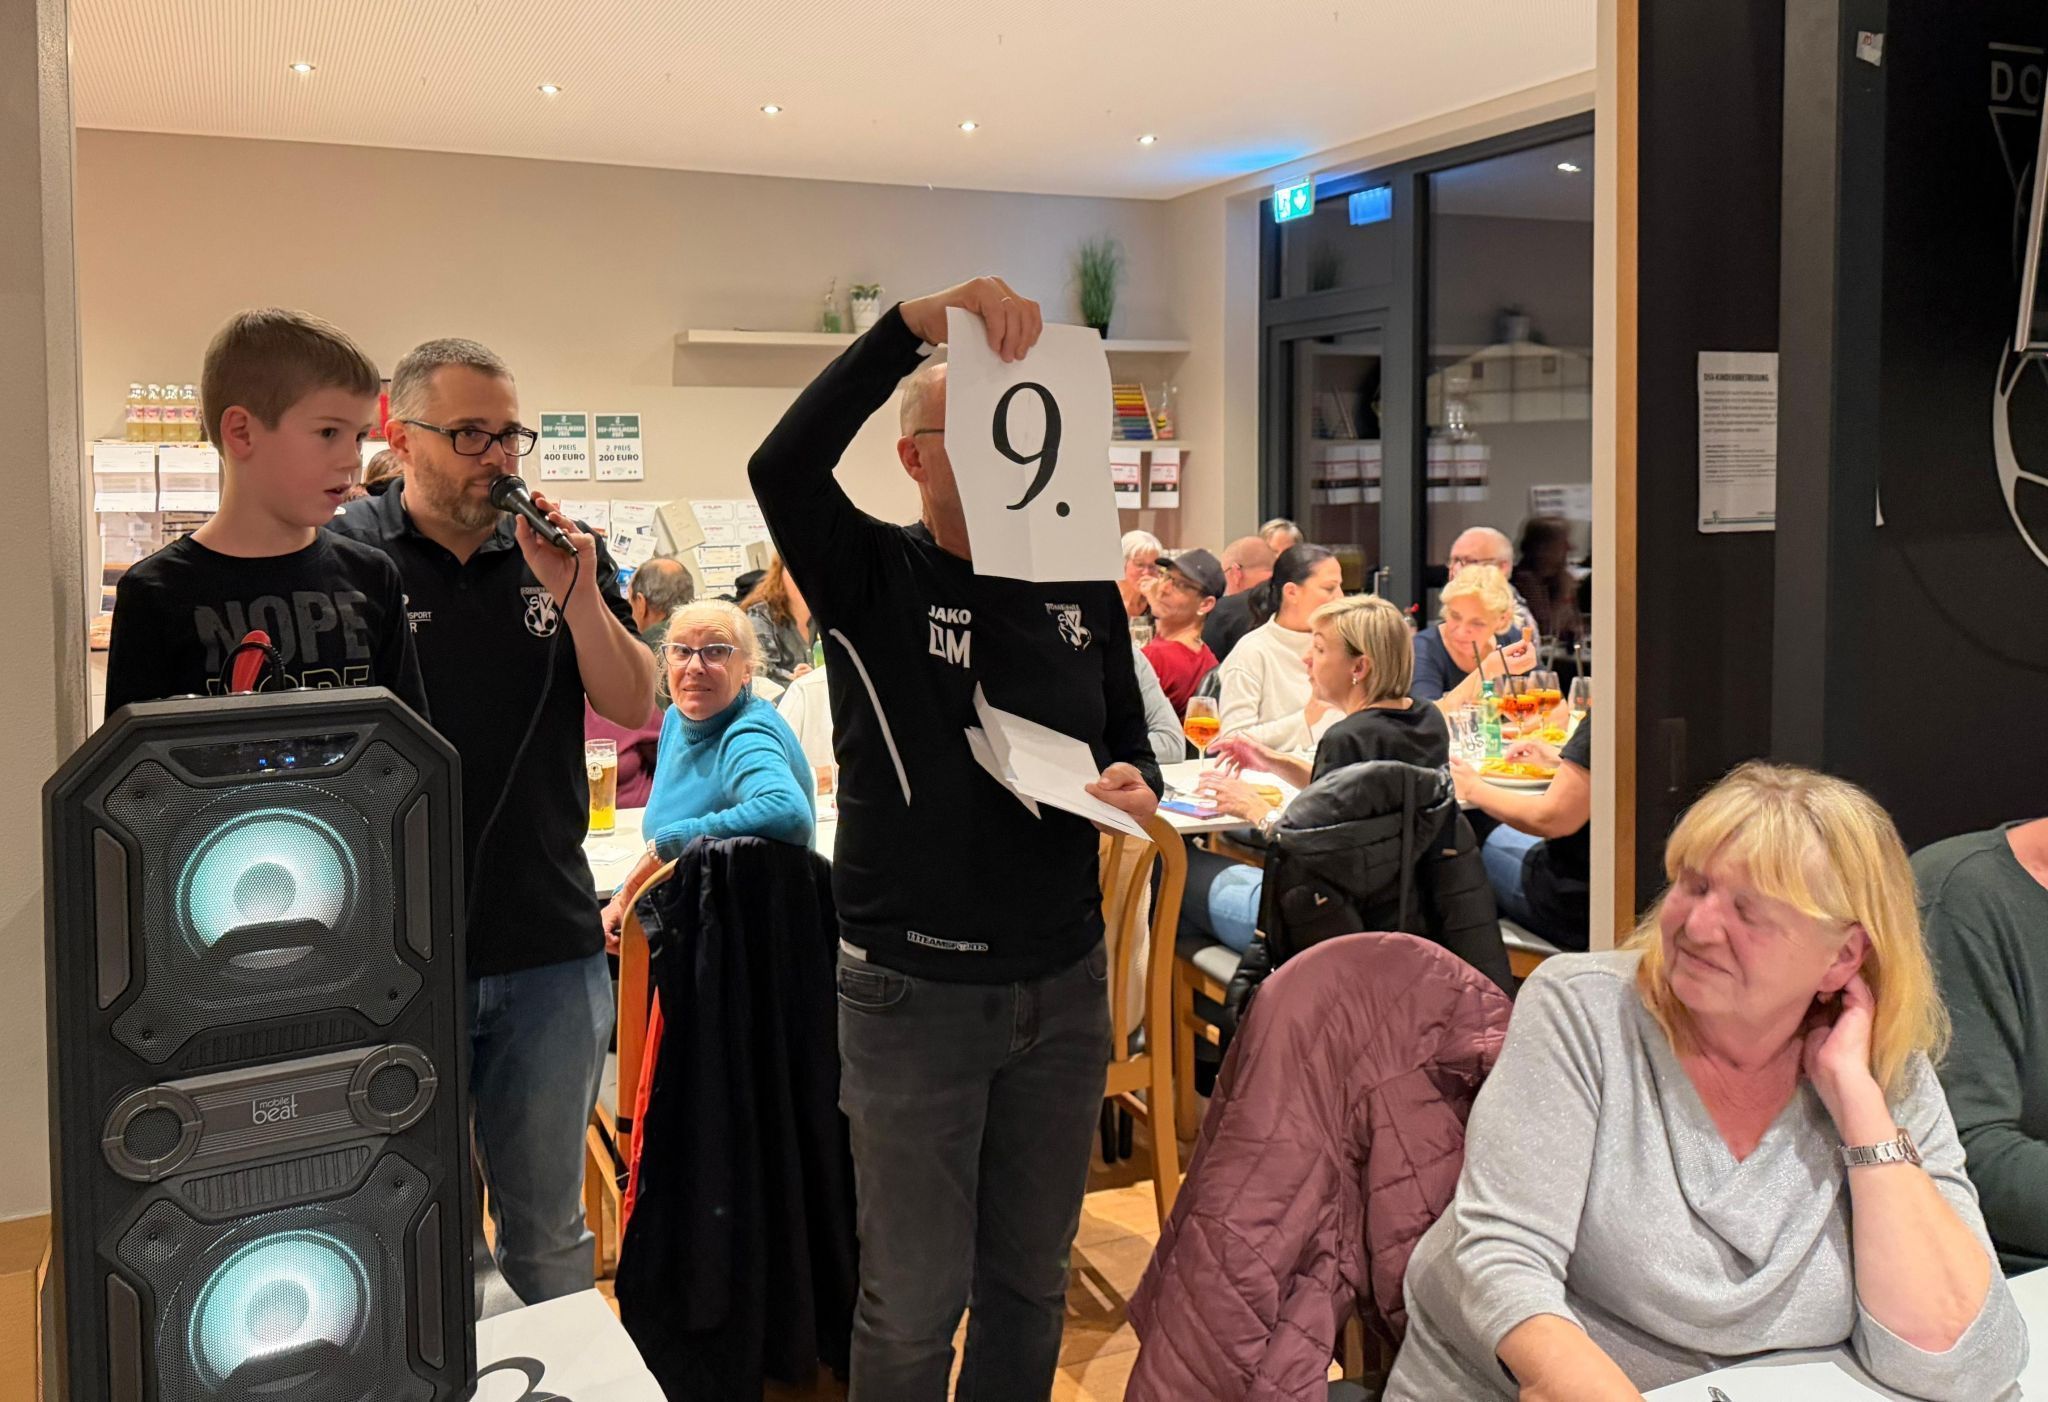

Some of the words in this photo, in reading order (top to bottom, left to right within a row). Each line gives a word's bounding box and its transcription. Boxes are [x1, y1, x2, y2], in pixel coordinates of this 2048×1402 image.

[614, 444, 631, 452] PREIS
[992, 381, 1070, 517] 9.
[544, 453, 561, 461] 400
[562, 453, 586, 461] EURO
[599, 454, 615, 462] 200
[616, 453, 639, 461] EURO
[928, 605, 972, 625] JAKO
[194, 591, 370, 673] NOPE
[252, 1093, 298, 1125] beat
[260, 1097, 290, 1109] mobile
